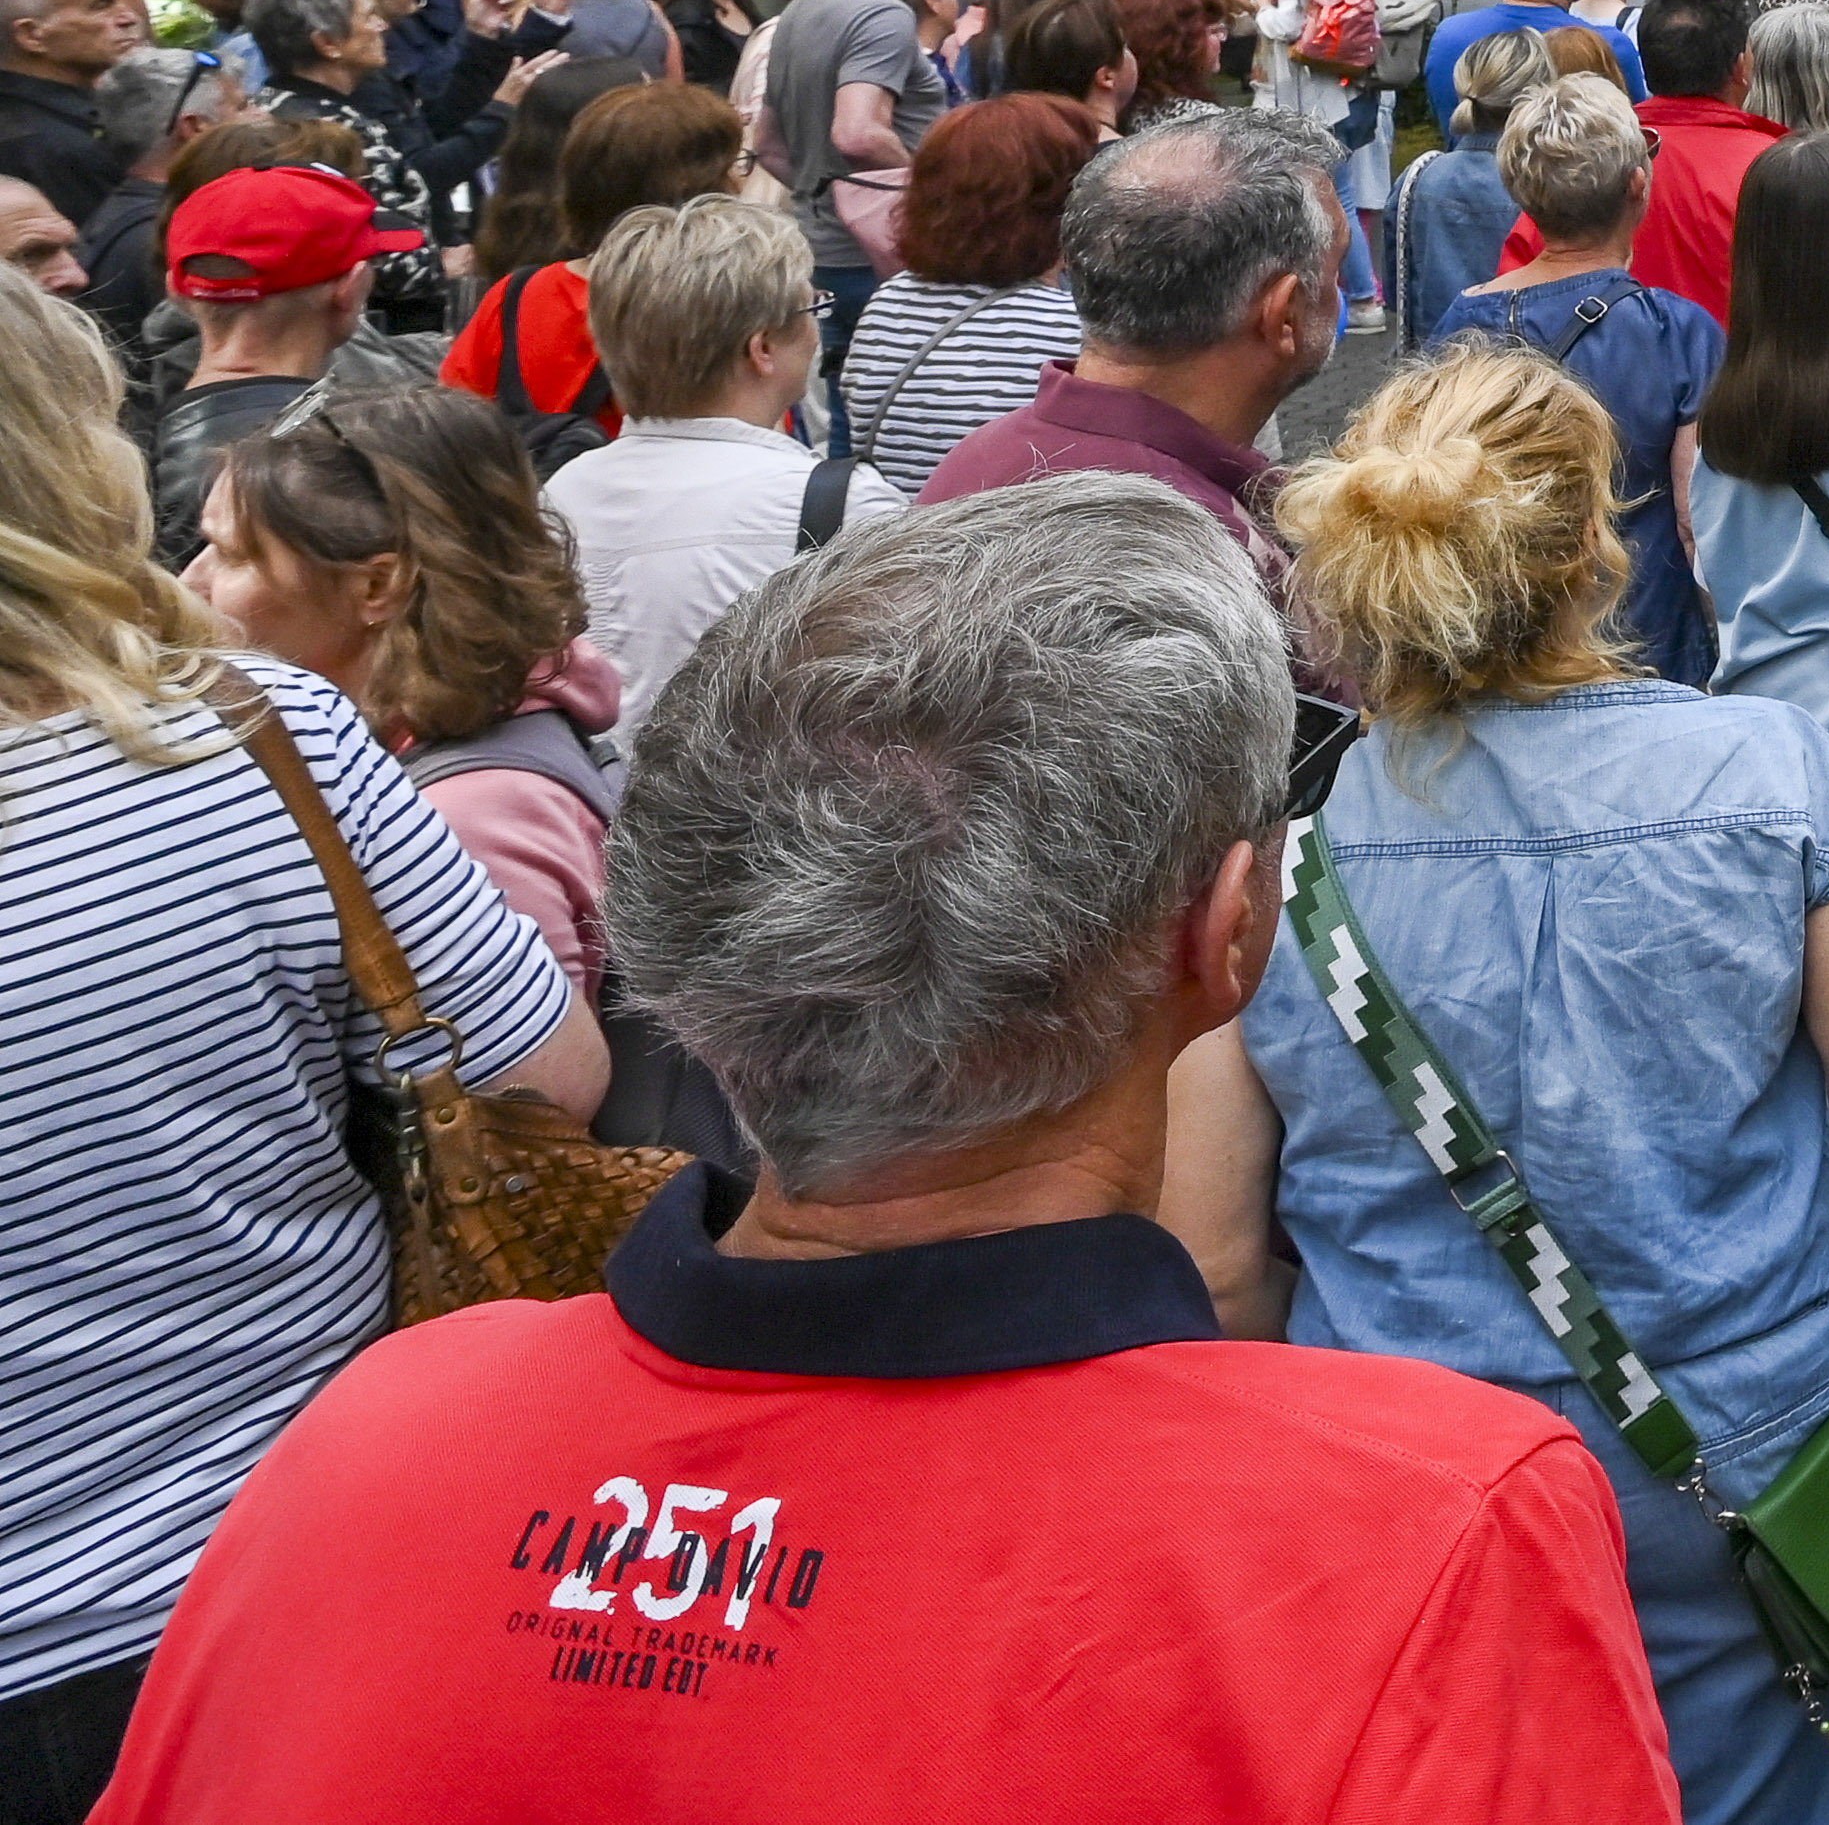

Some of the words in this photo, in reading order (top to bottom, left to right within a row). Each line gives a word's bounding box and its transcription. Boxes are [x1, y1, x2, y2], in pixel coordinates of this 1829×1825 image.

[511, 1510, 649, 1585] CAMP
[666, 1531, 825, 1609] DAVID
[549, 1475, 782, 1632] 251
[550, 1645, 657, 1690] LIMITED
[632, 1626, 780, 1668] TRADEMARK
